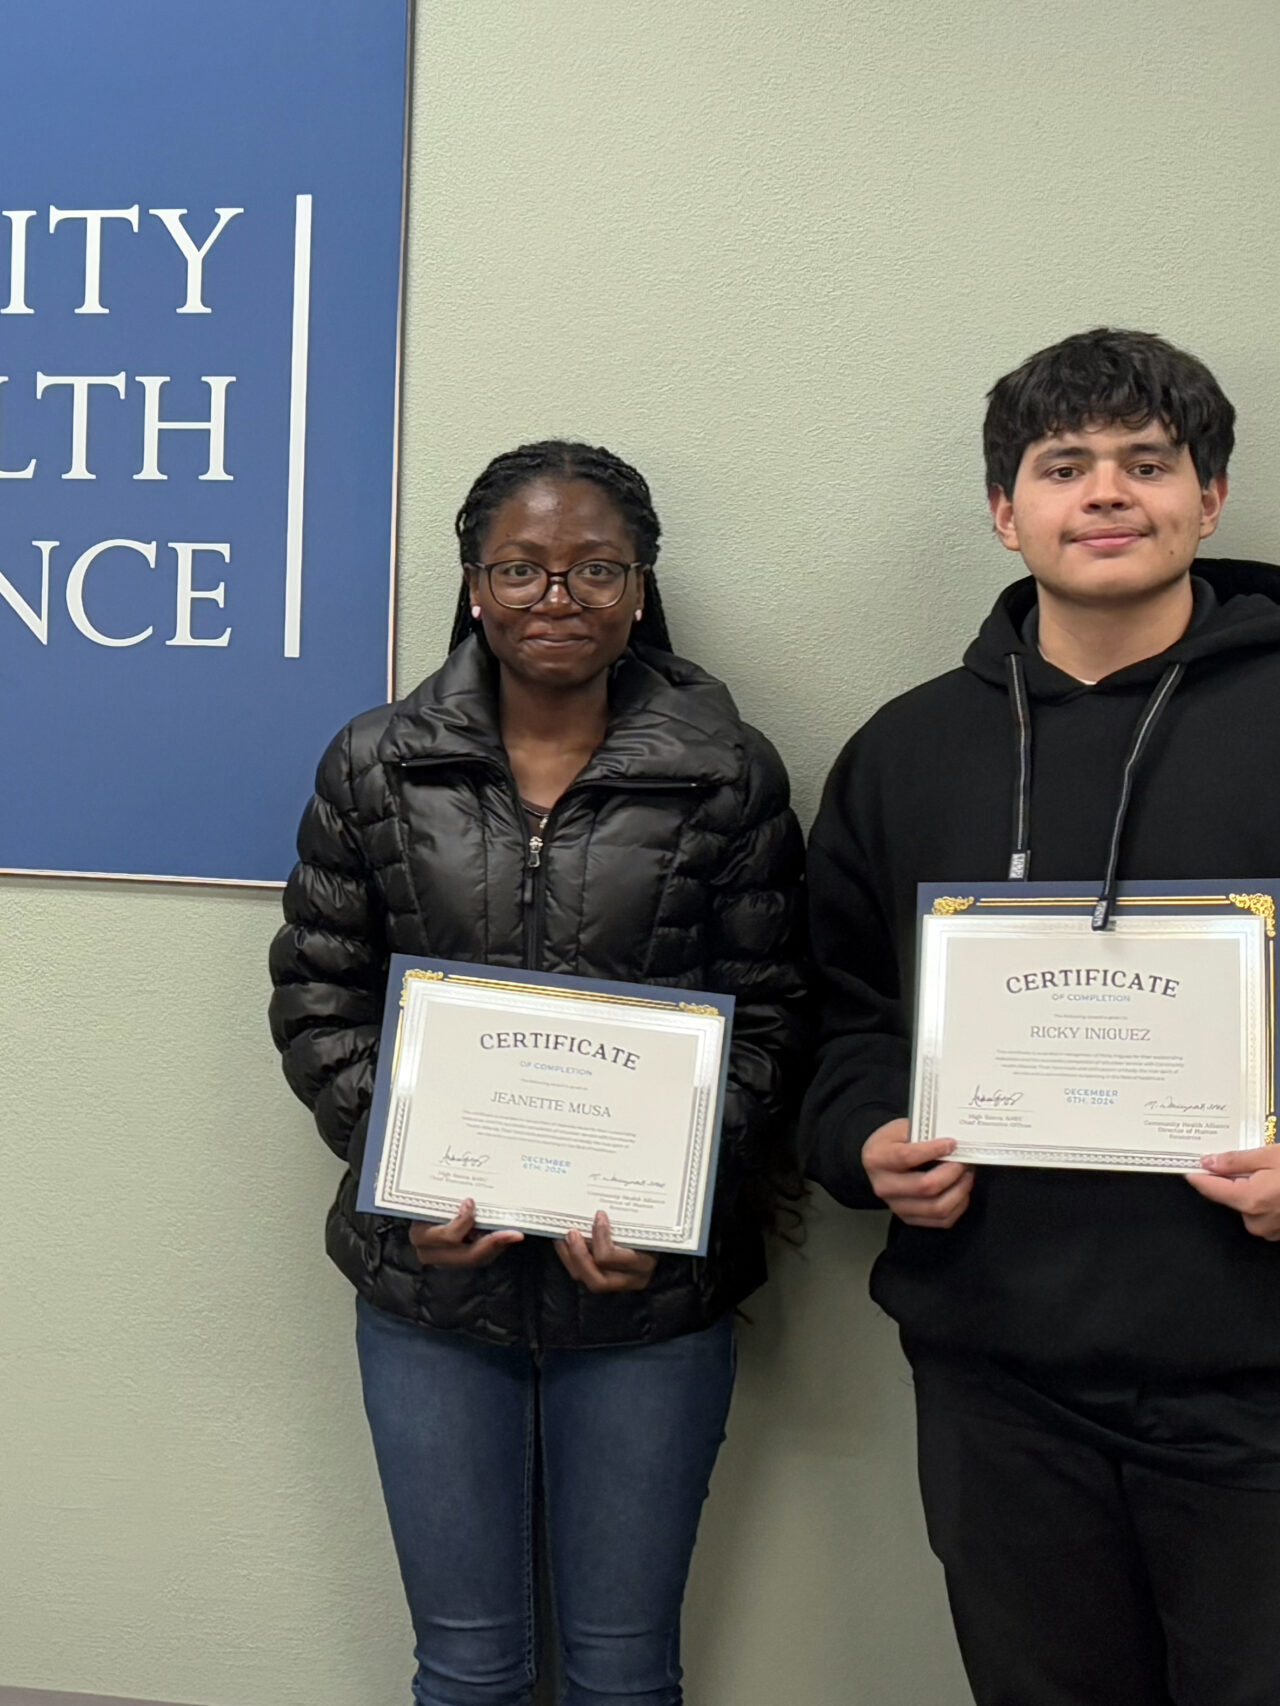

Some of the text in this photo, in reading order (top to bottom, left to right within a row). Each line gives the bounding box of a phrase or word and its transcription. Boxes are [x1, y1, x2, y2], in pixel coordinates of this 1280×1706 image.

[1006, 969, 1180, 998] CERTIFICATE
[1068, 994, 1131, 1002] COMPLETION
[1030, 1026, 1151, 1042] RICKY INIGUEZ
[480, 1032, 641, 1070] CERTIFICATE
[534, 1062, 592, 1076] COMPLETION
[1064, 1088, 1118, 1097] DECEMBER
[490, 1091, 612, 1118] JEANETTE MUSA
[1091, 1097, 1114, 1105] 2024
[521, 1155, 571, 1167] DECEMBER
[544, 1165, 567, 1174] 2024
